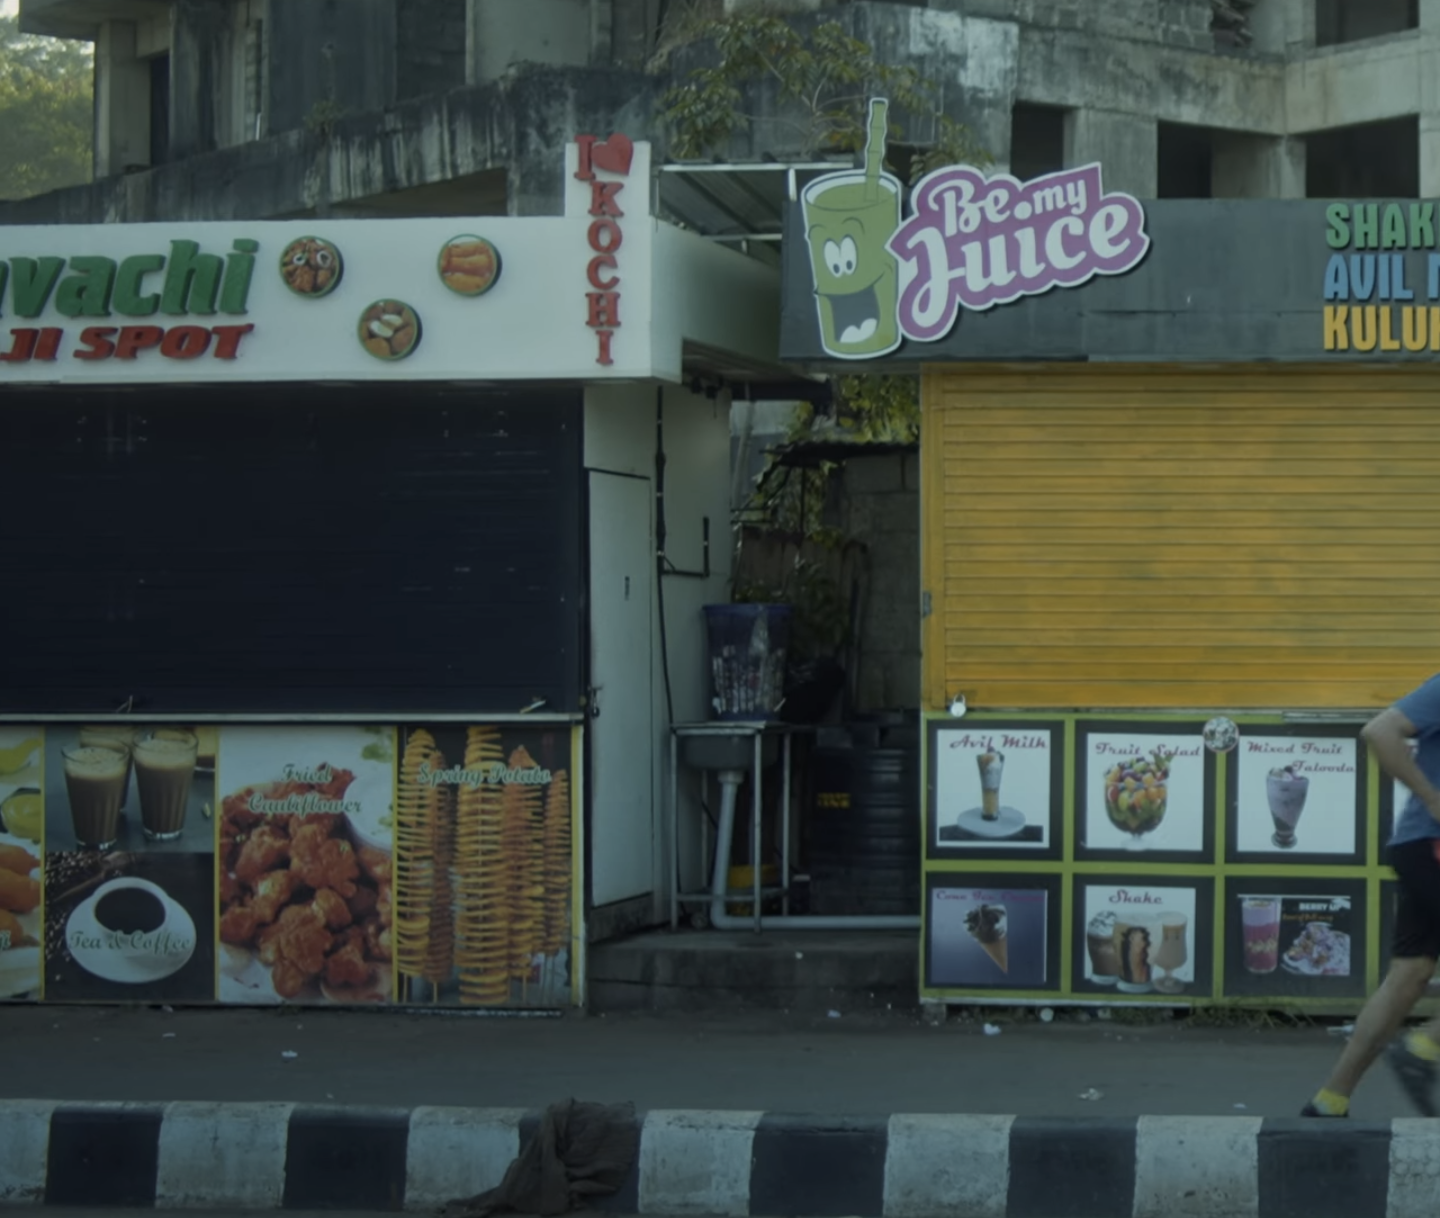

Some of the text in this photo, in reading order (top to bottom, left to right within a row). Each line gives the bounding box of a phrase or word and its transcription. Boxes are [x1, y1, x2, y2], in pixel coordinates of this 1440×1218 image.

[574, 135, 624, 365] I KOCHI
[907, 204, 1131, 328] Juice
[1323, 253, 1414, 301] AVIL
[73, 323, 255, 360] SPOT
[950, 734, 1047, 750] Avil Milk
[1095, 742, 1202, 757] Fruit Salad
[1247, 741, 1343, 755] Mixed Fruit
[281, 763, 333, 784] Fried
[417, 763, 552, 790] Spring Potato
[248, 792, 362, 818] Cauliflower
[1109, 889, 1163, 905] Shake
[70, 930, 190, 955] Tea & Coffee
